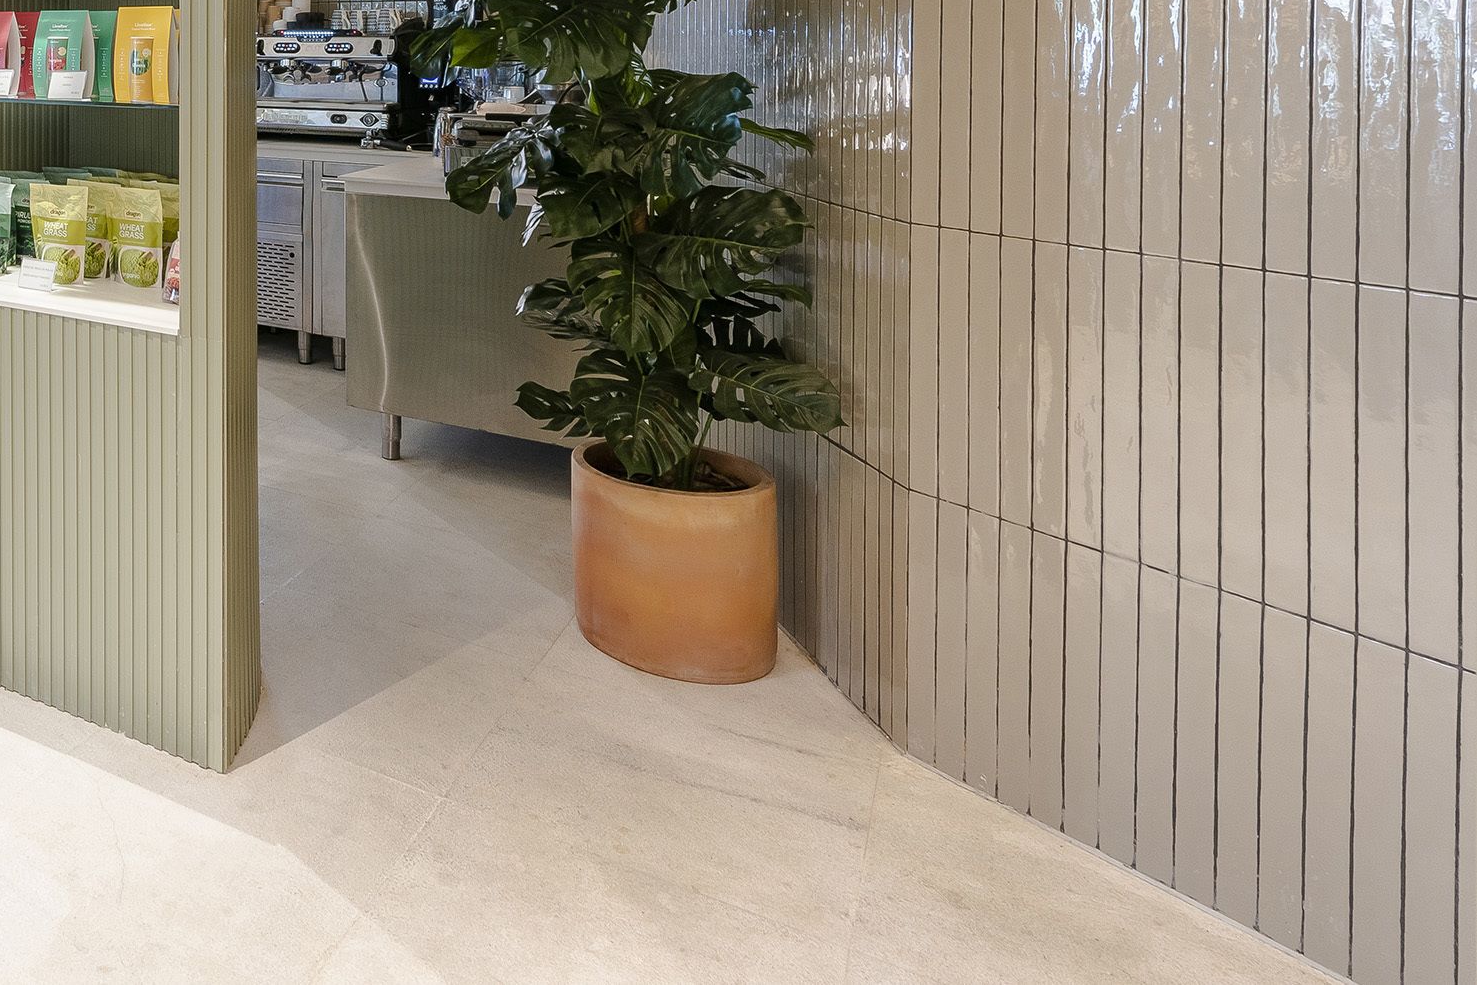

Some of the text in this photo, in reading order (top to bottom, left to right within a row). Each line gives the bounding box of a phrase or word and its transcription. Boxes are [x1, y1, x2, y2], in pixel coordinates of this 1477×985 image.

[44, 221, 69, 230] WHEAT
[119, 223, 145, 231] WHEAT
[44, 229, 68, 238] GRASS
[119, 231, 144, 240] GRASS
